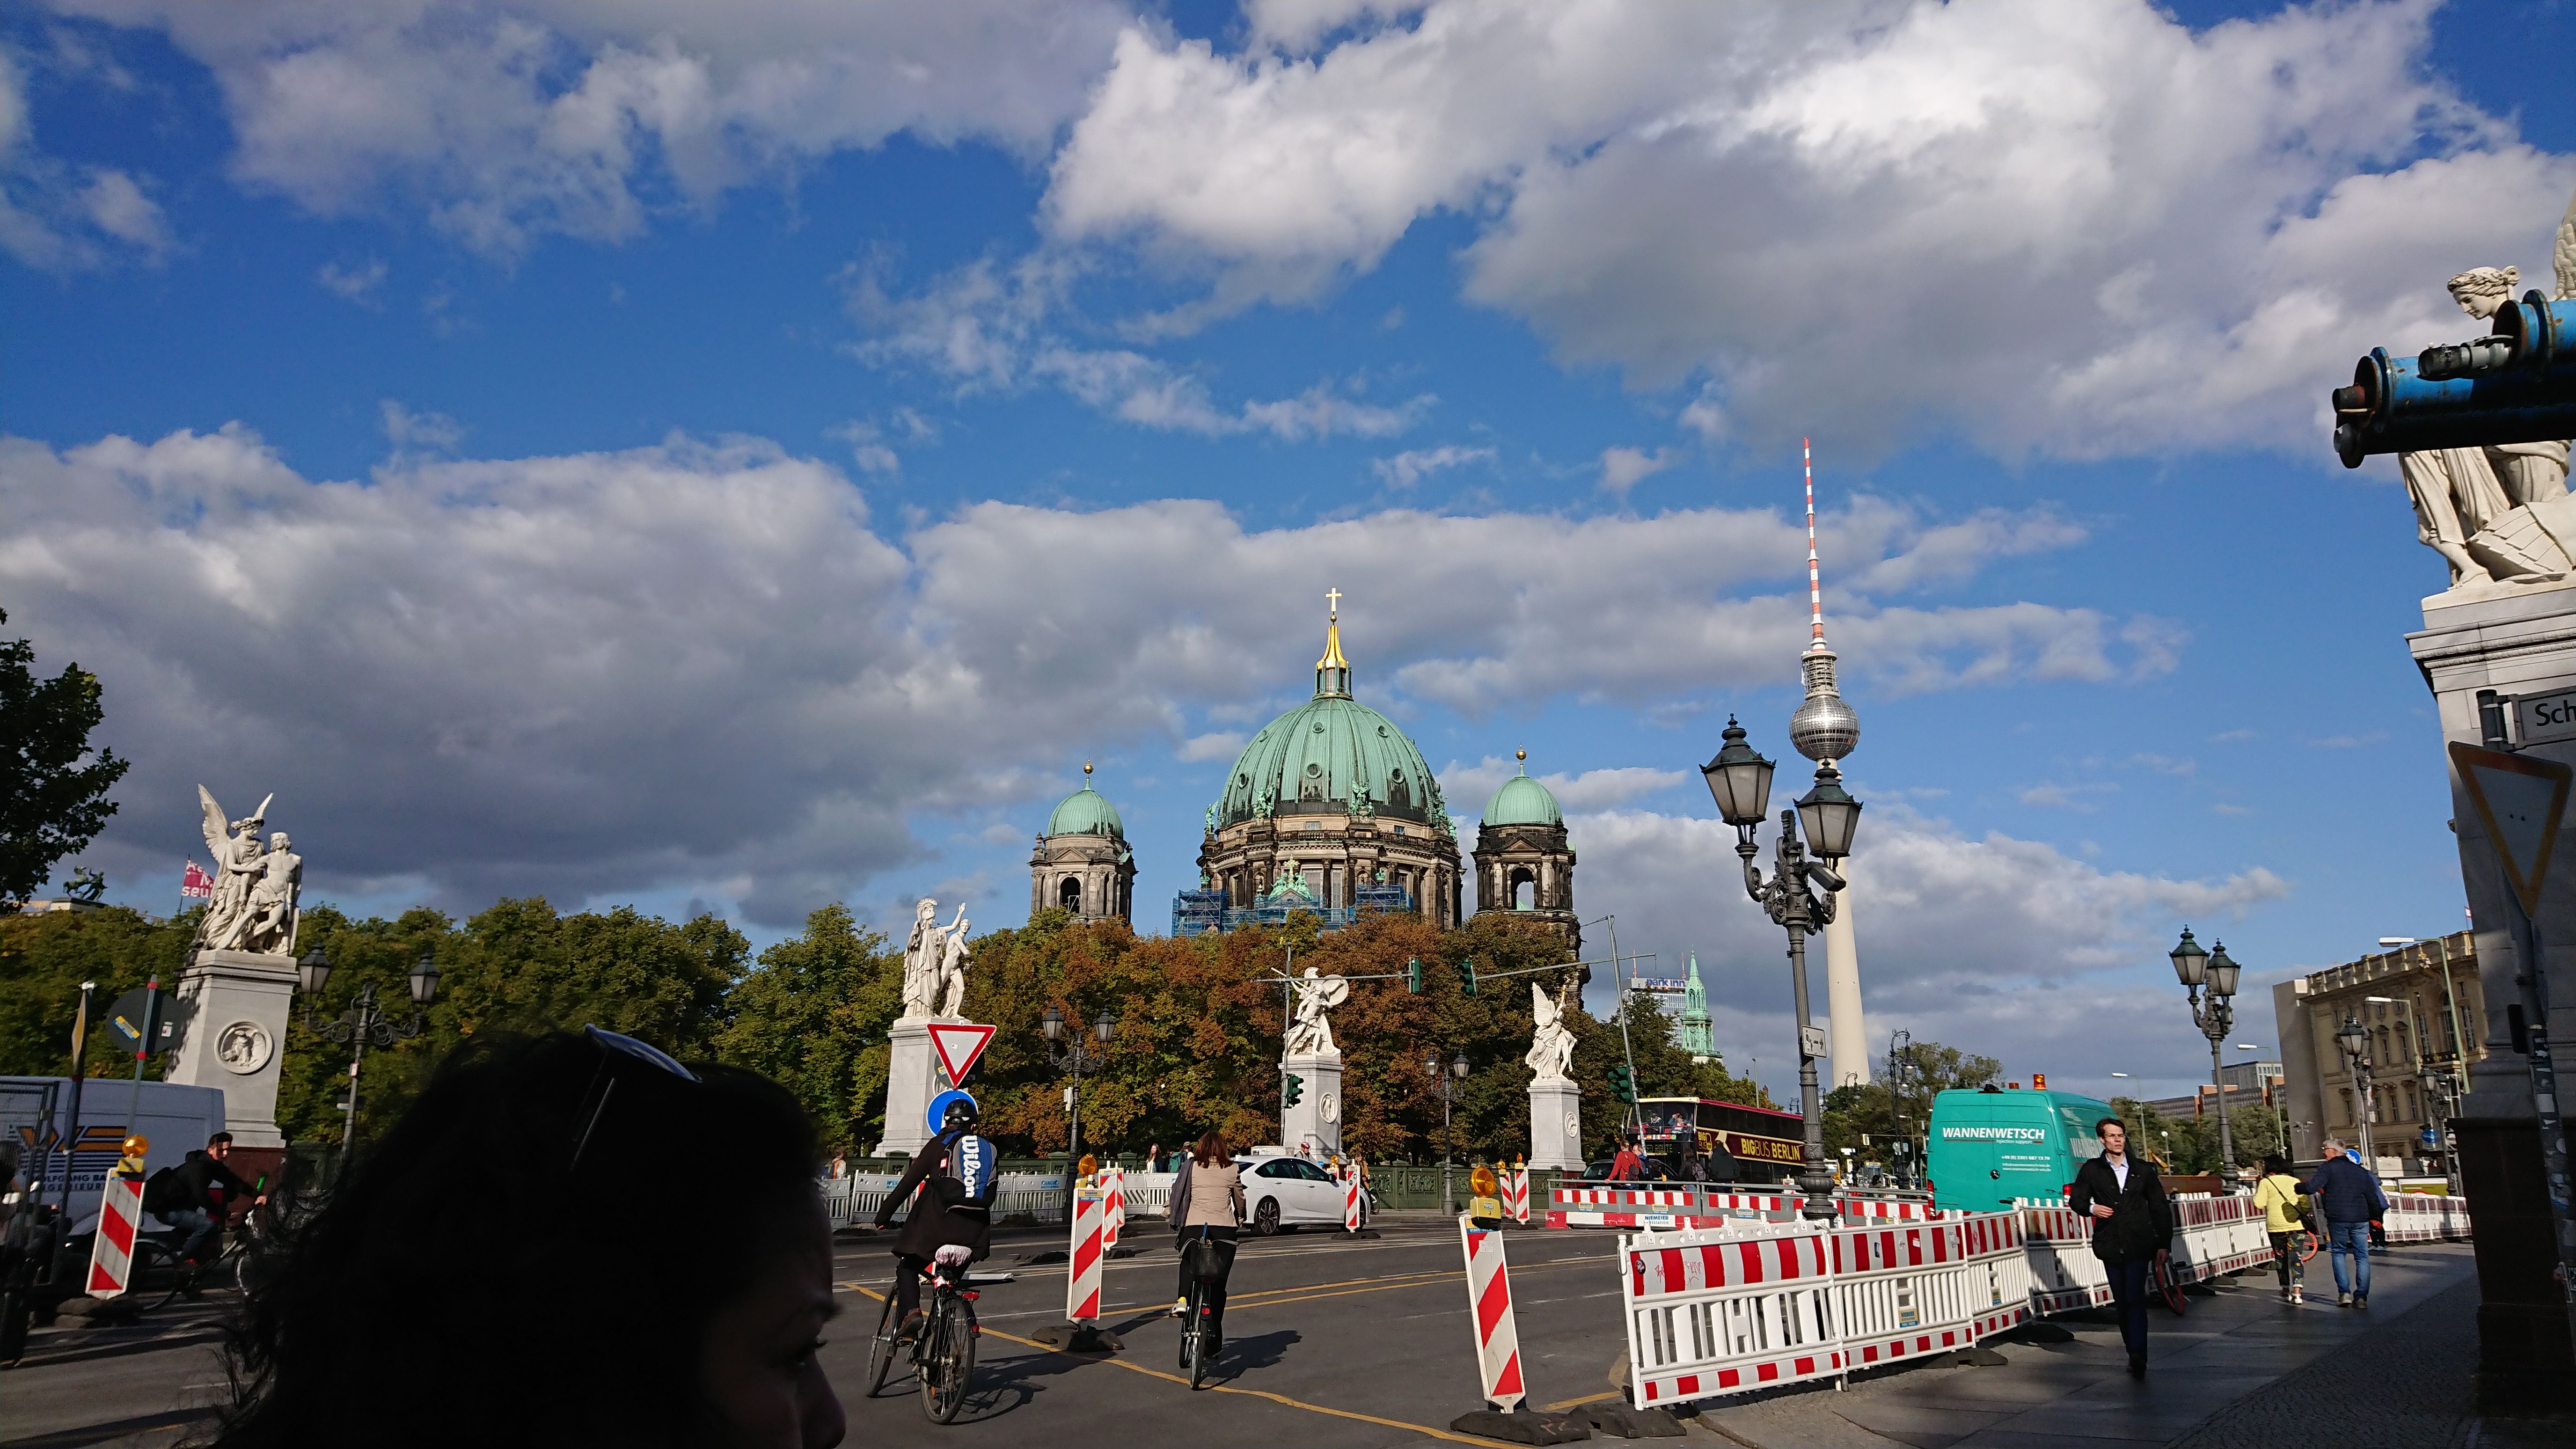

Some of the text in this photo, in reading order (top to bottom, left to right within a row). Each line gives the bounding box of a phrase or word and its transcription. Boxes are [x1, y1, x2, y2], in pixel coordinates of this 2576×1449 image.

[2535, 700, 2576, 726] Sch
[1646, 978, 1669, 986] park
[1698, 1131, 1706, 1141] BIG
[1942, 1127, 2045, 1140] WANNENWETSCH
[1771, 1142, 1800, 1161] BERLIN
[962, 1135, 981, 1198] Wilson
